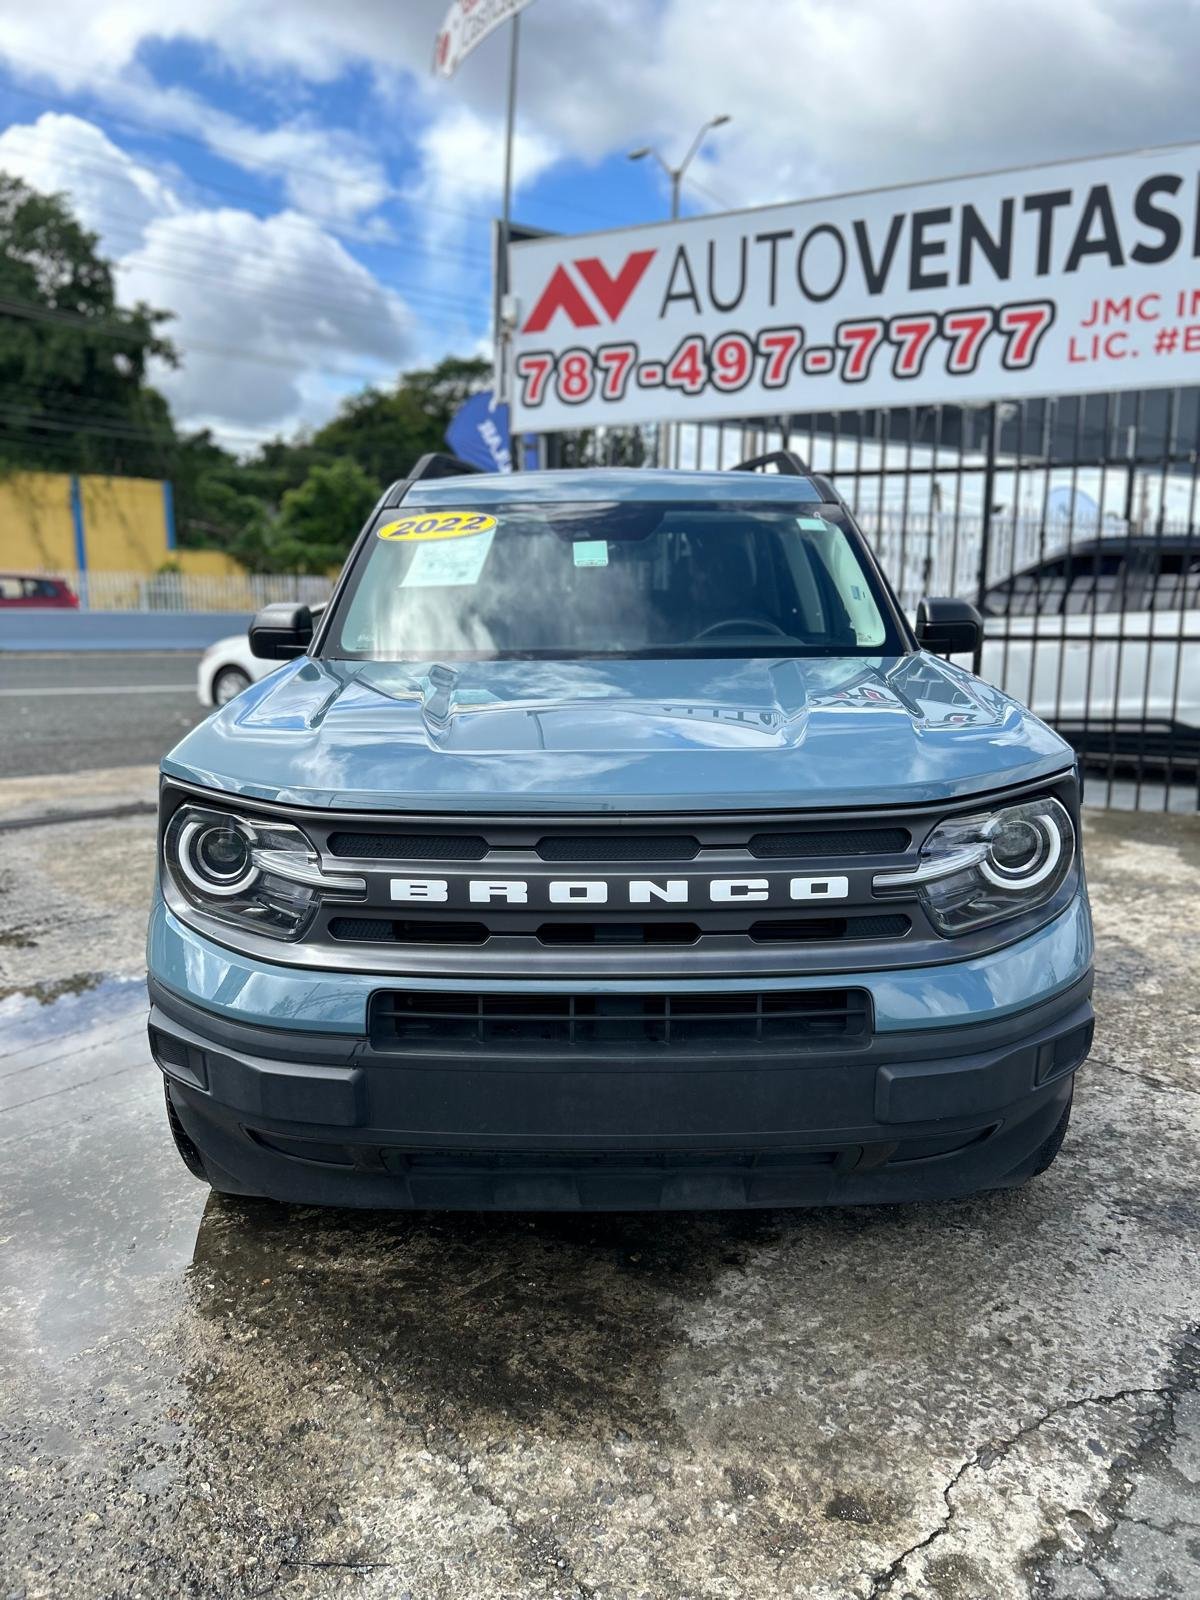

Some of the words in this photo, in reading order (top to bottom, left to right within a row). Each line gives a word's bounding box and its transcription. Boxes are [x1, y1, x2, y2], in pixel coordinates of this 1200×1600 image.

[658, 170, 1200, 320] AUTOVENTAS
[1081, 292, 1162, 328] JMC
[517, 298, 1056, 408] 787-497-7777
[1066, 331, 1139, 363] LIC.
[388, 516, 487, 537] 2022
[390, 876, 848, 903] BRONCO
